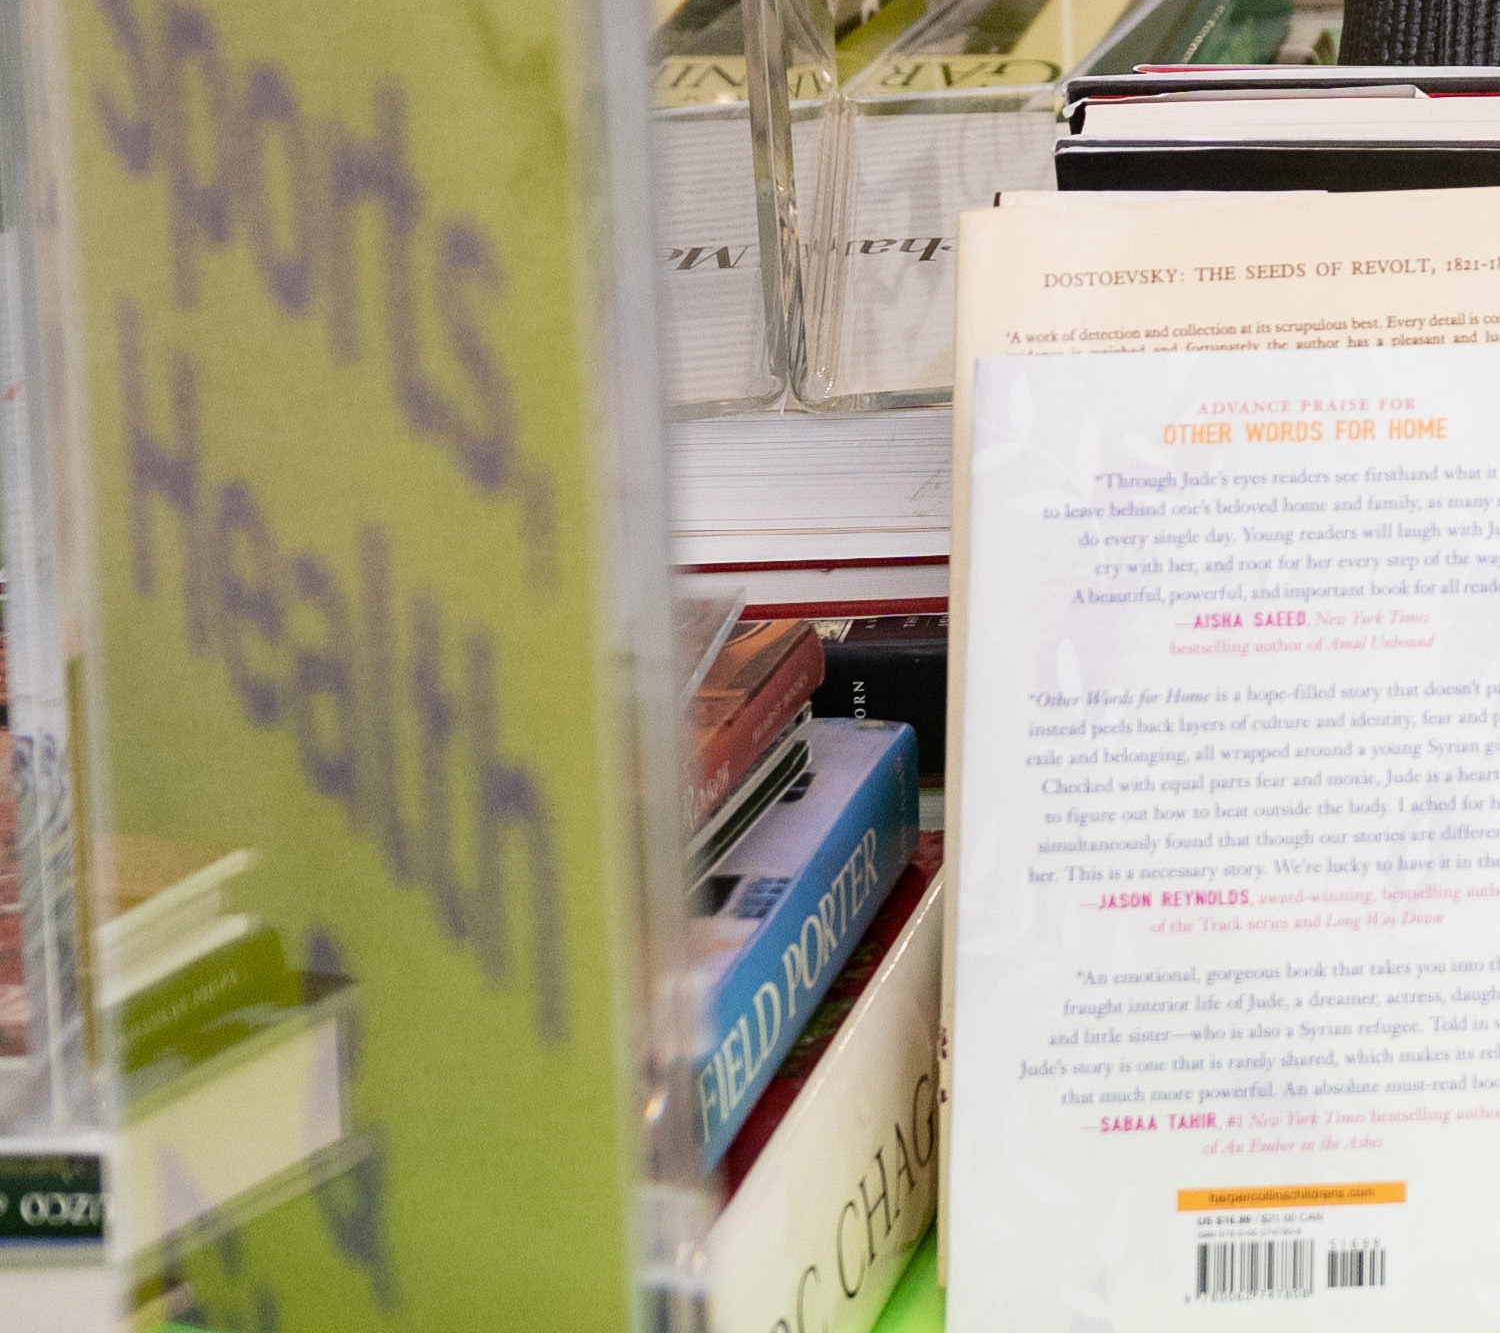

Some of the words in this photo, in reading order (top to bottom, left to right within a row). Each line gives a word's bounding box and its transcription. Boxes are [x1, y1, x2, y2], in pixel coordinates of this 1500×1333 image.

[1043, 264, 1185, 288] DOSTOEVSKY:
[1193, 262, 1237, 282] THE
[1245, 259, 1307, 280] SEEDS
[1314, 258, 1342, 277] OF
[1350, 254, 1441, 280] REVOLT,
[1025, 328, 1058, 344] work
[1062, 327, 1076, 342] of
[1079, 324, 1141, 342] detection
[1144, 323, 1170, 339] and
[1173, 320, 1237, 338] collection
[1240, 322, 1252, 335] at
[1255, 321, 1271, 334] its
[1274, 316, 1348, 339] scrupulous
[1351, 314, 1384, 330] best.
[1386, 312, 1425, 334] Every
[1428, 311, 1466, 327] detail
[1469, 312, 1480, 326] is
[1199, 399, 1291, 414] ADVANCE
[1299, 397, 1369, 412] PRAISE
[1377, 396, 1415, 410] FOR
[1162, 422, 1235, 445] OTHER
[1243, 420, 1325, 443] WORDS
[1333, 419, 1377, 441] FOR
[1385, 417, 1446, 439] HOME
[1181, 469, 1228, 487] Jude’s
[1232, 473, 1267, 490] eyes
[1272, 467, 1330, 484] readers
[1335, 471, 1358, 483] see
[1364, 464, 1438, 482] firsthand
[1444, 463, 1481, 480] what
[1486, 464, 1497, 479] it
[1042, 504, 1060, 519] to
[1064, 501, 1105, 518] leave
[1108, 499, 1166, 517] behind
[1171, 498, 1211, 516] one’s
[1215, 496, 1278, 514] beloved
[1282, 495, 1327, 513] home
[1333, 494, 1362, 511] and
[1367, 492, 1424, 515] family,
[1427, 497, 1442, 509] as
[1447, 496, 1491, 513] many
[1078, 530, 1099, 547] do
[1104, 534, 1147, 551] every
[1153, 527, 1199, 550] single
[1205, 526, 1238, 548] day.
[1242, 525, 1294, 548] Young
[1299, 523, 1357, 541] readers
[1363, 522, 1392, 539] will
[1397, 521, 1441, 544] laugh
[1447, 520, 1483, 537] with
[1094, 562, 1121, 580] cry
[1126, 556, 1163, 574] with
[1168, 555, 1202, 576] her,
[1204, 555, 1234, 572] and
[1238, 556, 1272, 571] root
[1278, 553, 1301, 570] for
[1305, 552, 1332, 569] her
[1338, 556, 1380, 574] every
[1387, 552, 1419, 572] step
[1424, 550, 1440, 566] of
[1445, 549, 1470, 566] the
[1073, 588, 1085, 604] A
[1088, 585, 1167, 607] beautiful,
[1169, 583, 1249, 607] powerful,
[1251, 582, 1281, 600] and
[1284, 582, 1364, 604] important
[1370, 579, 1409, 597] book
[1413, 578, 1435, 595] for
[1440, 578, 1460, 595] all
[695, 978, 783, 1145] FIELD
[780, 826, 880, 1020] PORTER
[835, 1072, 938, 1301] CHAG
